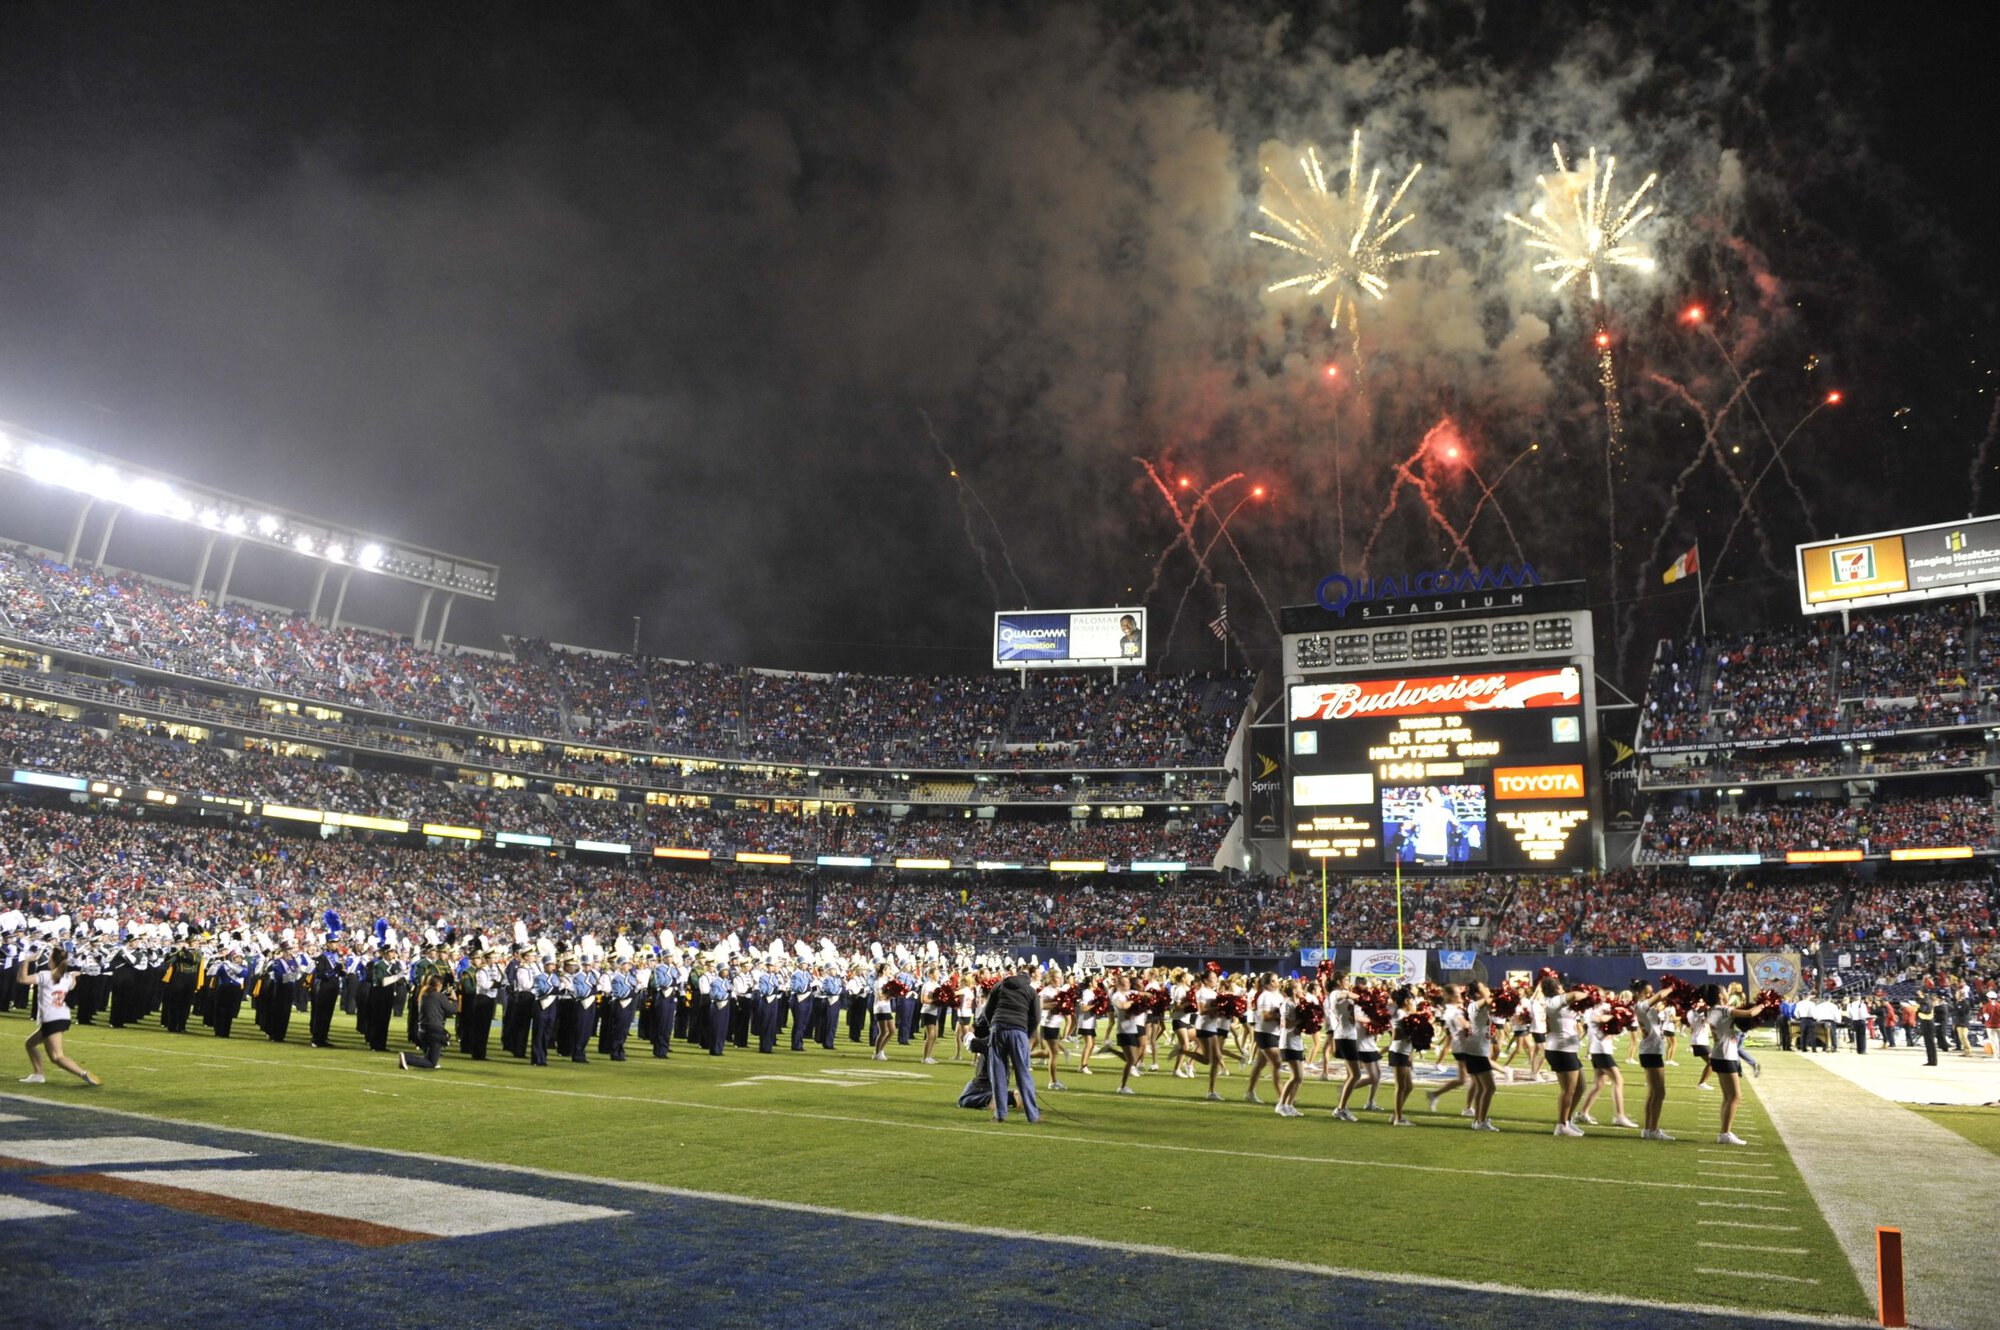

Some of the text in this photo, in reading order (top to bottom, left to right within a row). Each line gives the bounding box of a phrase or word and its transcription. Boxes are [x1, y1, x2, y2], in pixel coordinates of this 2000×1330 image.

[1841, 552, 1864, 566] 7
[1909, 556, 1952, 568] Imaging
[1316, 563, 1540, 617] QUALCOMM
[1362, 594, 1524, 617] STADIUM
[1001, 628, 1067, 643] QUALCOMM
[1322, 673, 1506, 719] Budweiser
[1444, 715, 1462, 727] TO
[1388, 731, 1411, 745] DR
[1251, 780, 1281, 793] Sprint
[1498, 773, 1580, 792] TOYOTA
[1714, 955, 1737, 973] N
